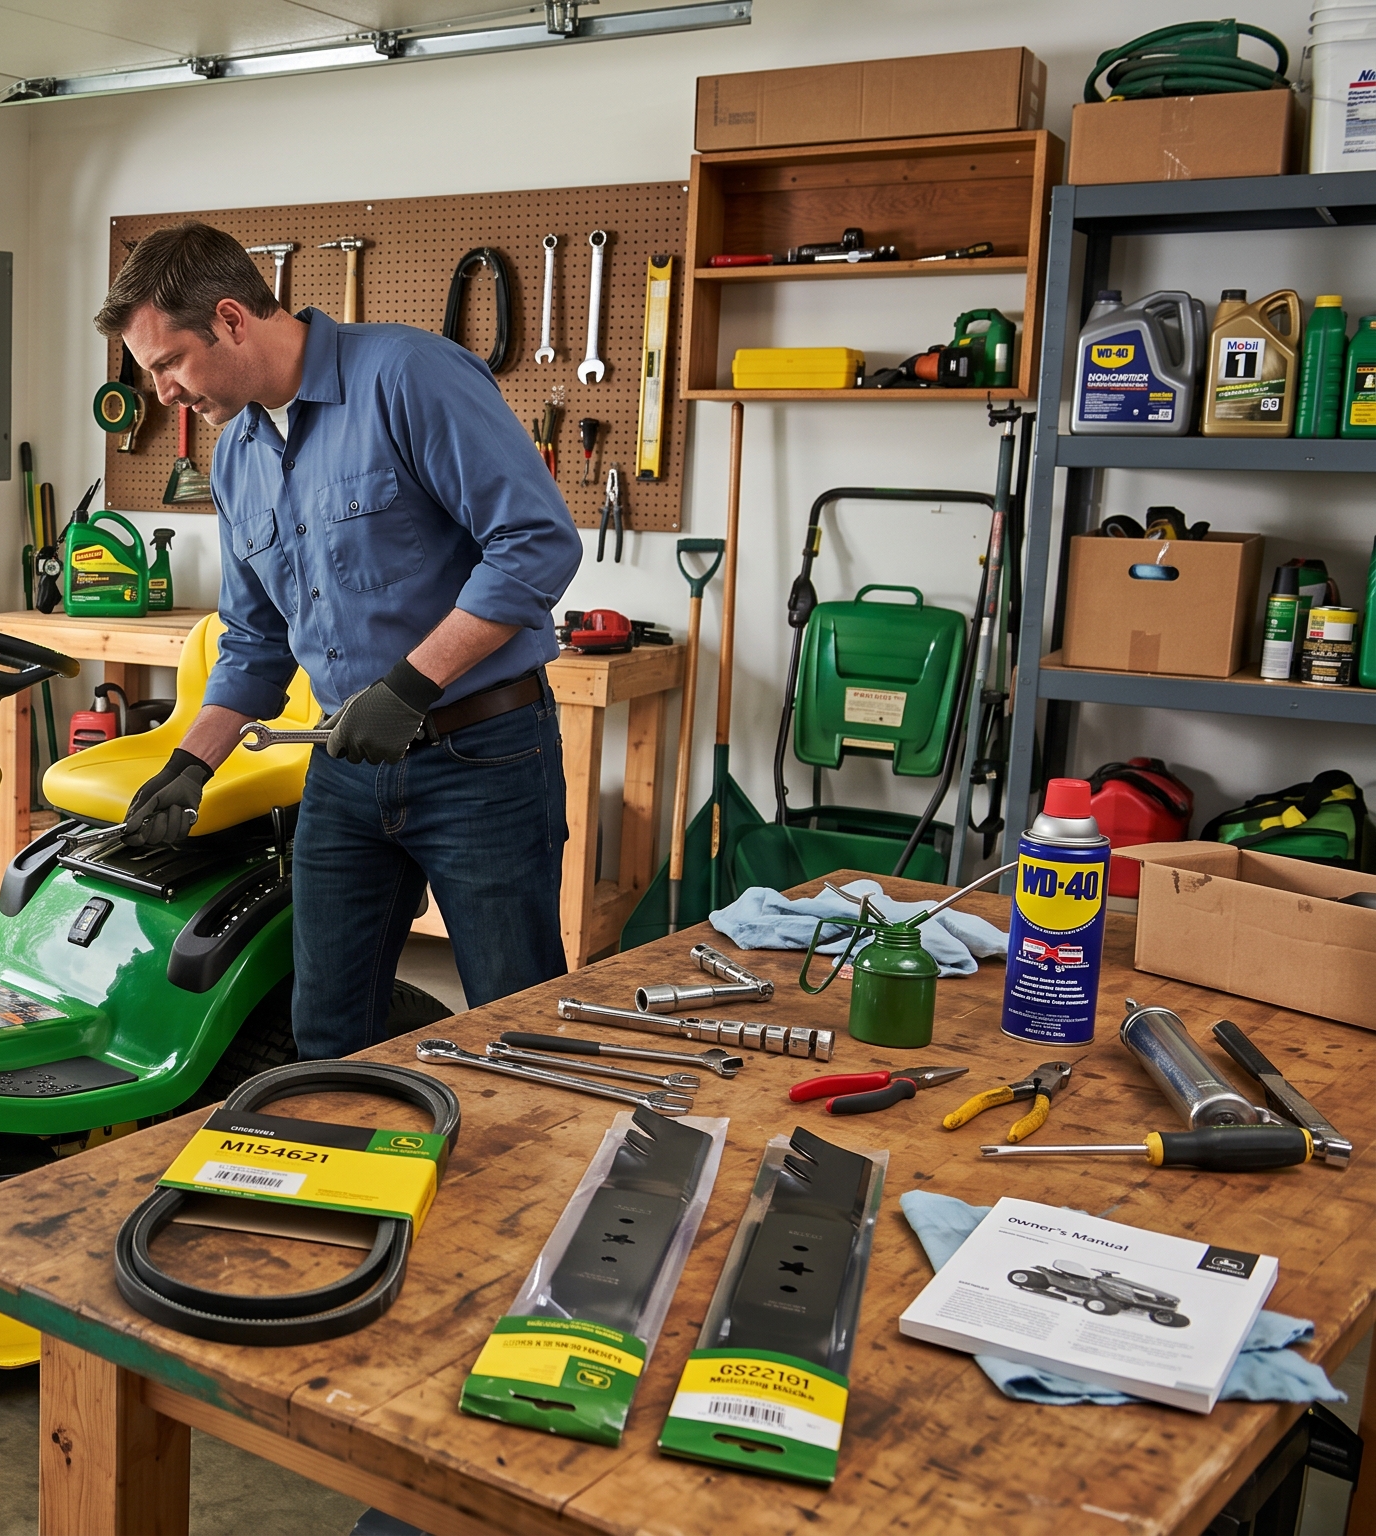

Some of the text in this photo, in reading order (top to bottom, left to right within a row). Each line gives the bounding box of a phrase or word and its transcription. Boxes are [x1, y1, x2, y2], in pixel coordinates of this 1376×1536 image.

[1227, 341, 1259, 350] Mobil
[1235, 353, 1246, 377] 1
[1022, 863, 1099, 901] WD-40
[220, 1140, 329, 1164] M154621
[1071, 1232, 1129, 1252] Manual
[719, 1364, 810, 1390] GS22101
